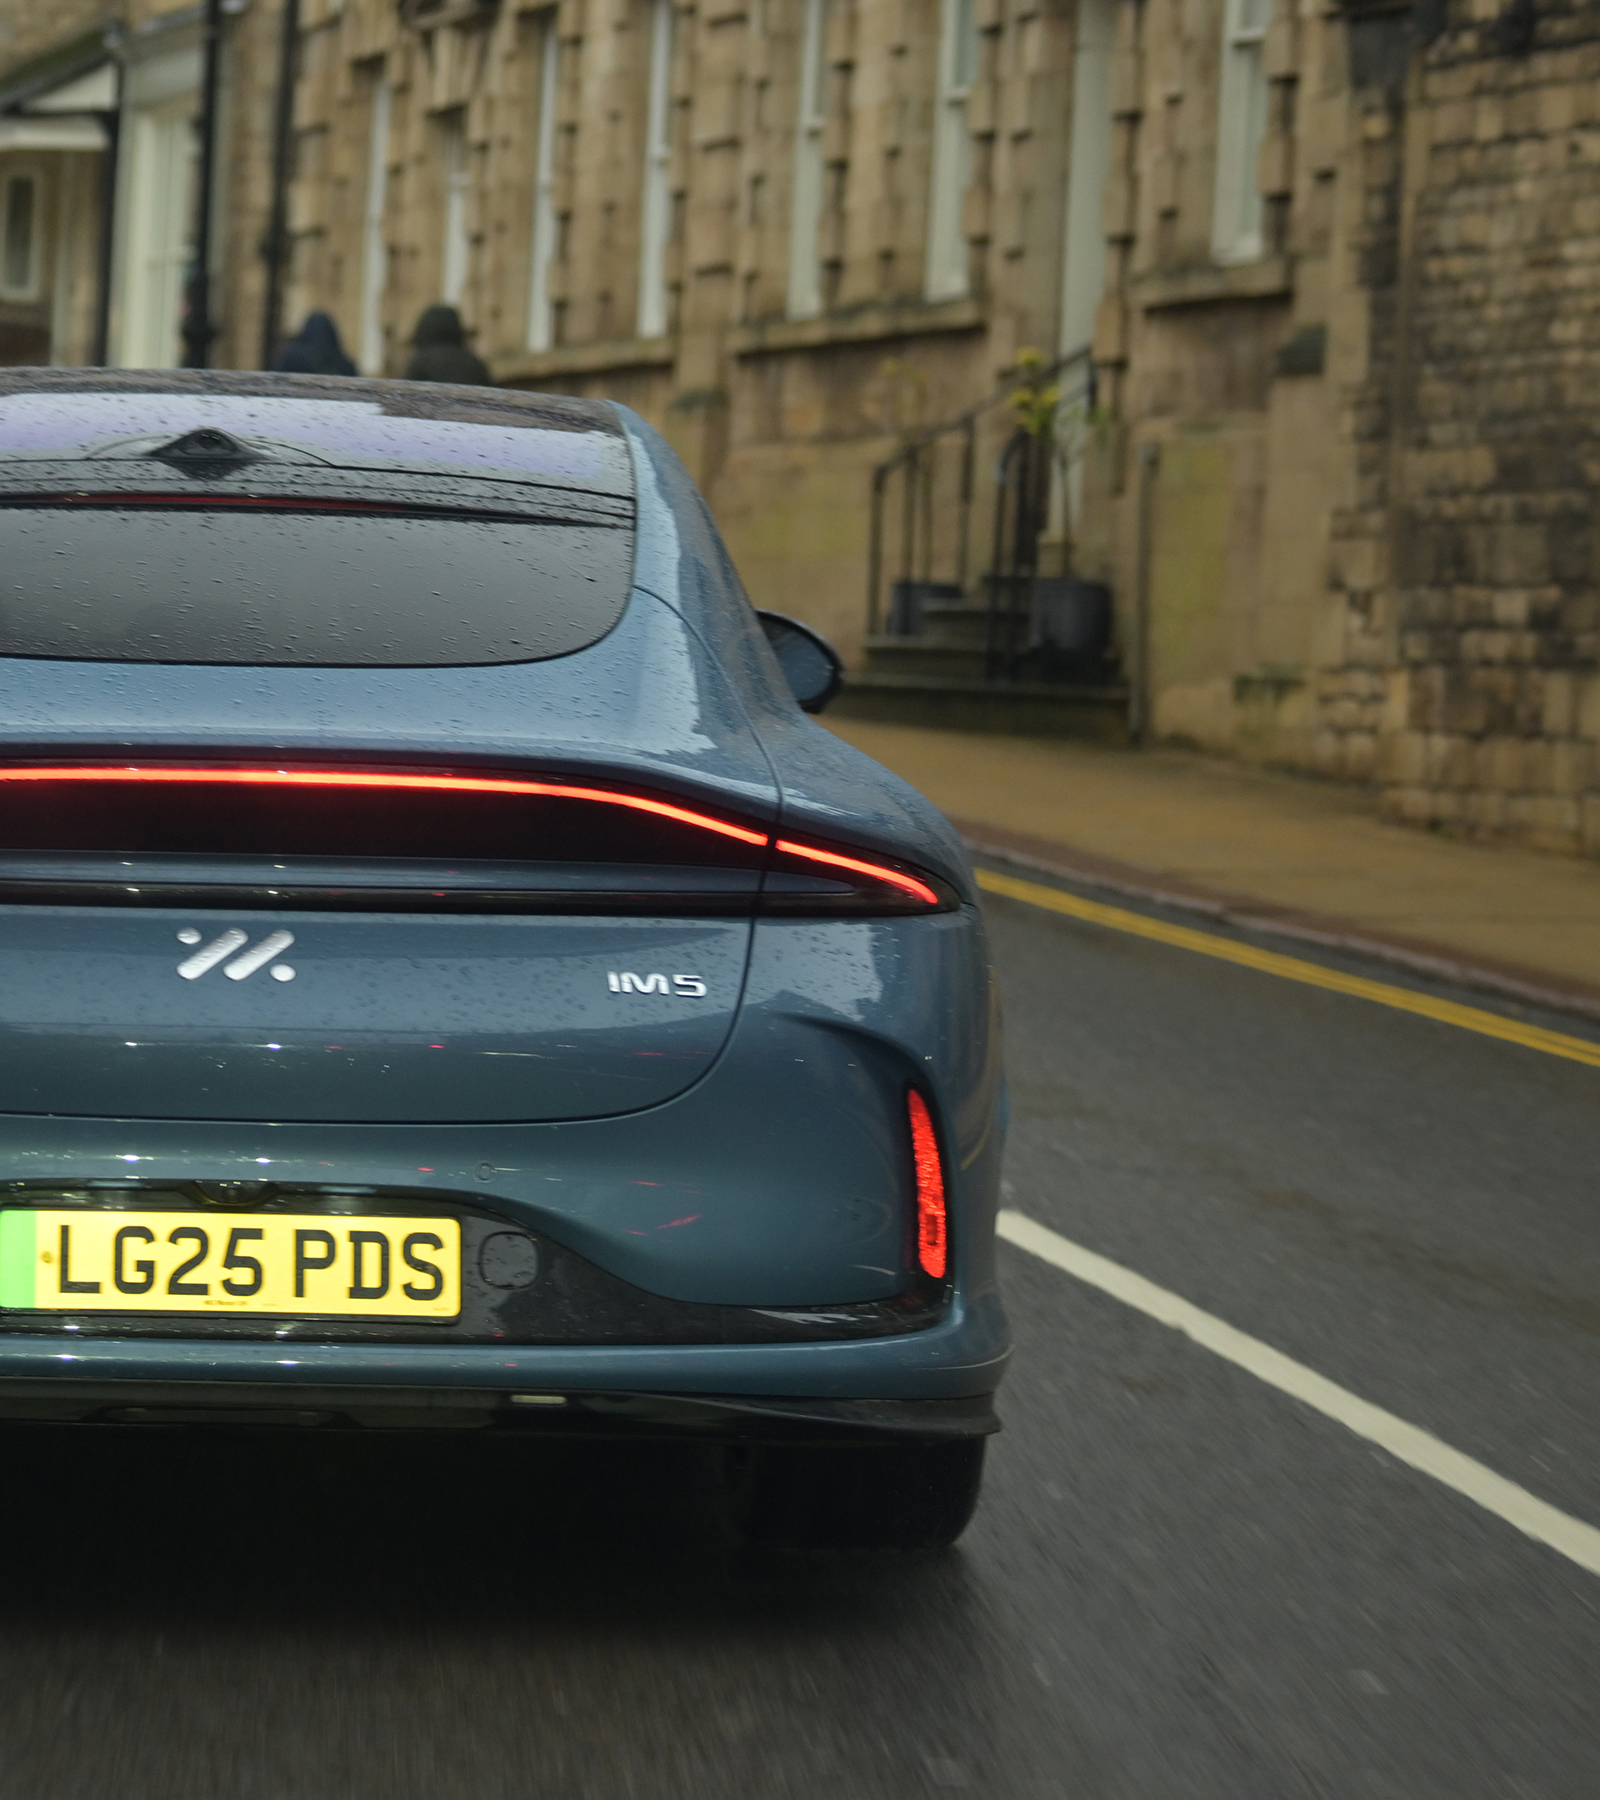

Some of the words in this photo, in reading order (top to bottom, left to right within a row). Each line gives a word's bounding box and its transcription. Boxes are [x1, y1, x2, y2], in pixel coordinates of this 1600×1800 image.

[607, 970, 708, 998] IM5
[59, 1225, 263, 1297] LG25
[295, 1229, 444, 1301] PDS
